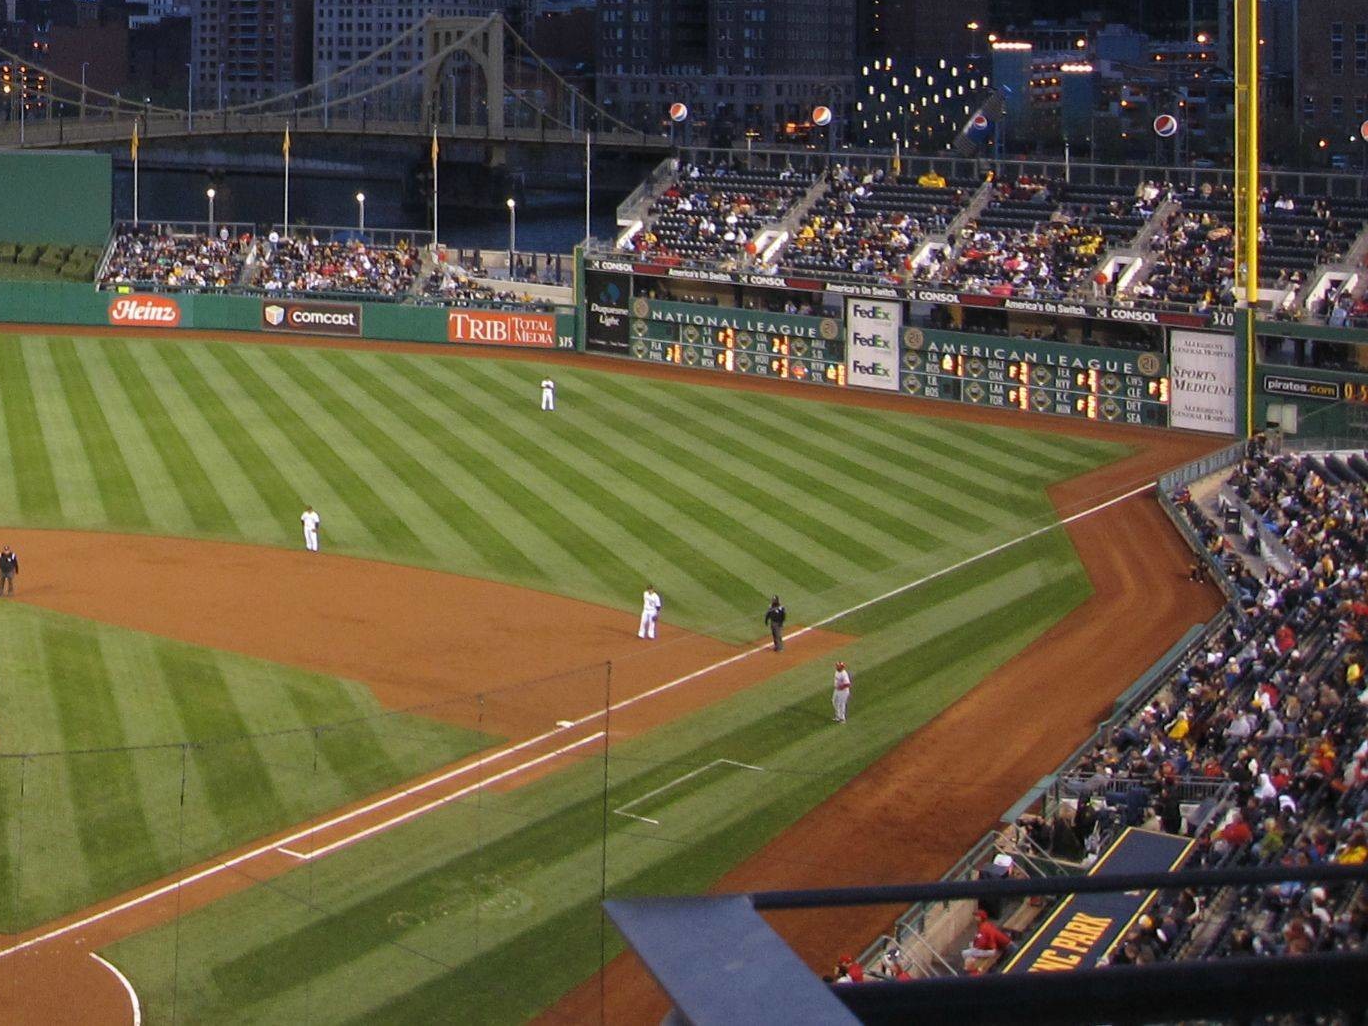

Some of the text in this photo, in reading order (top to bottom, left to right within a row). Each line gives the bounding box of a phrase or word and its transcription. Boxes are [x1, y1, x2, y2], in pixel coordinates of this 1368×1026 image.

[602, 261, 633, 272] CONSOL
[669, 268, 698, 278] America's
[699, 271, 708, 280] On
[750, 275, 787, 287] CONSOL
[825, 283, 860, 294] America's
[861, 285, 871, 294] On
[919, 291, 961, 303] CONSOL
[112, 300, 176, 321] Heinz
[853, 304, 890, 320] FedEx
[1005, 299, 1044, 312] America's
[1045, 303, 1056, 313] On
[292, 309, 356, 325] comcast
[1111, 309, 1158, 323] CONSOL
[1213, 312, 1234, 326] 320
[449, 313, 507, 341] TRIB
[512, 317, 552, 331] TOTAL
[652, 311, 817, 338] NATIONAL LEAGUE
[515, 332, 553, 344] MEDIA
[558, 336, 573, 348] 375
[853, 332, 890, 349] FedEx
[928, 342, 1132, 374] AMERICAN LEAGUE
[853, 360, 890, 377] FedEx
[1173, 366, 1216, 381] SPORTS
[1268, 380, 1335, 395] pirates.com
[1126, 412, 1142, 424] SEA
[1050, 912, 1113, 953] PARK
[1027, 949, 1082, 973] NC
